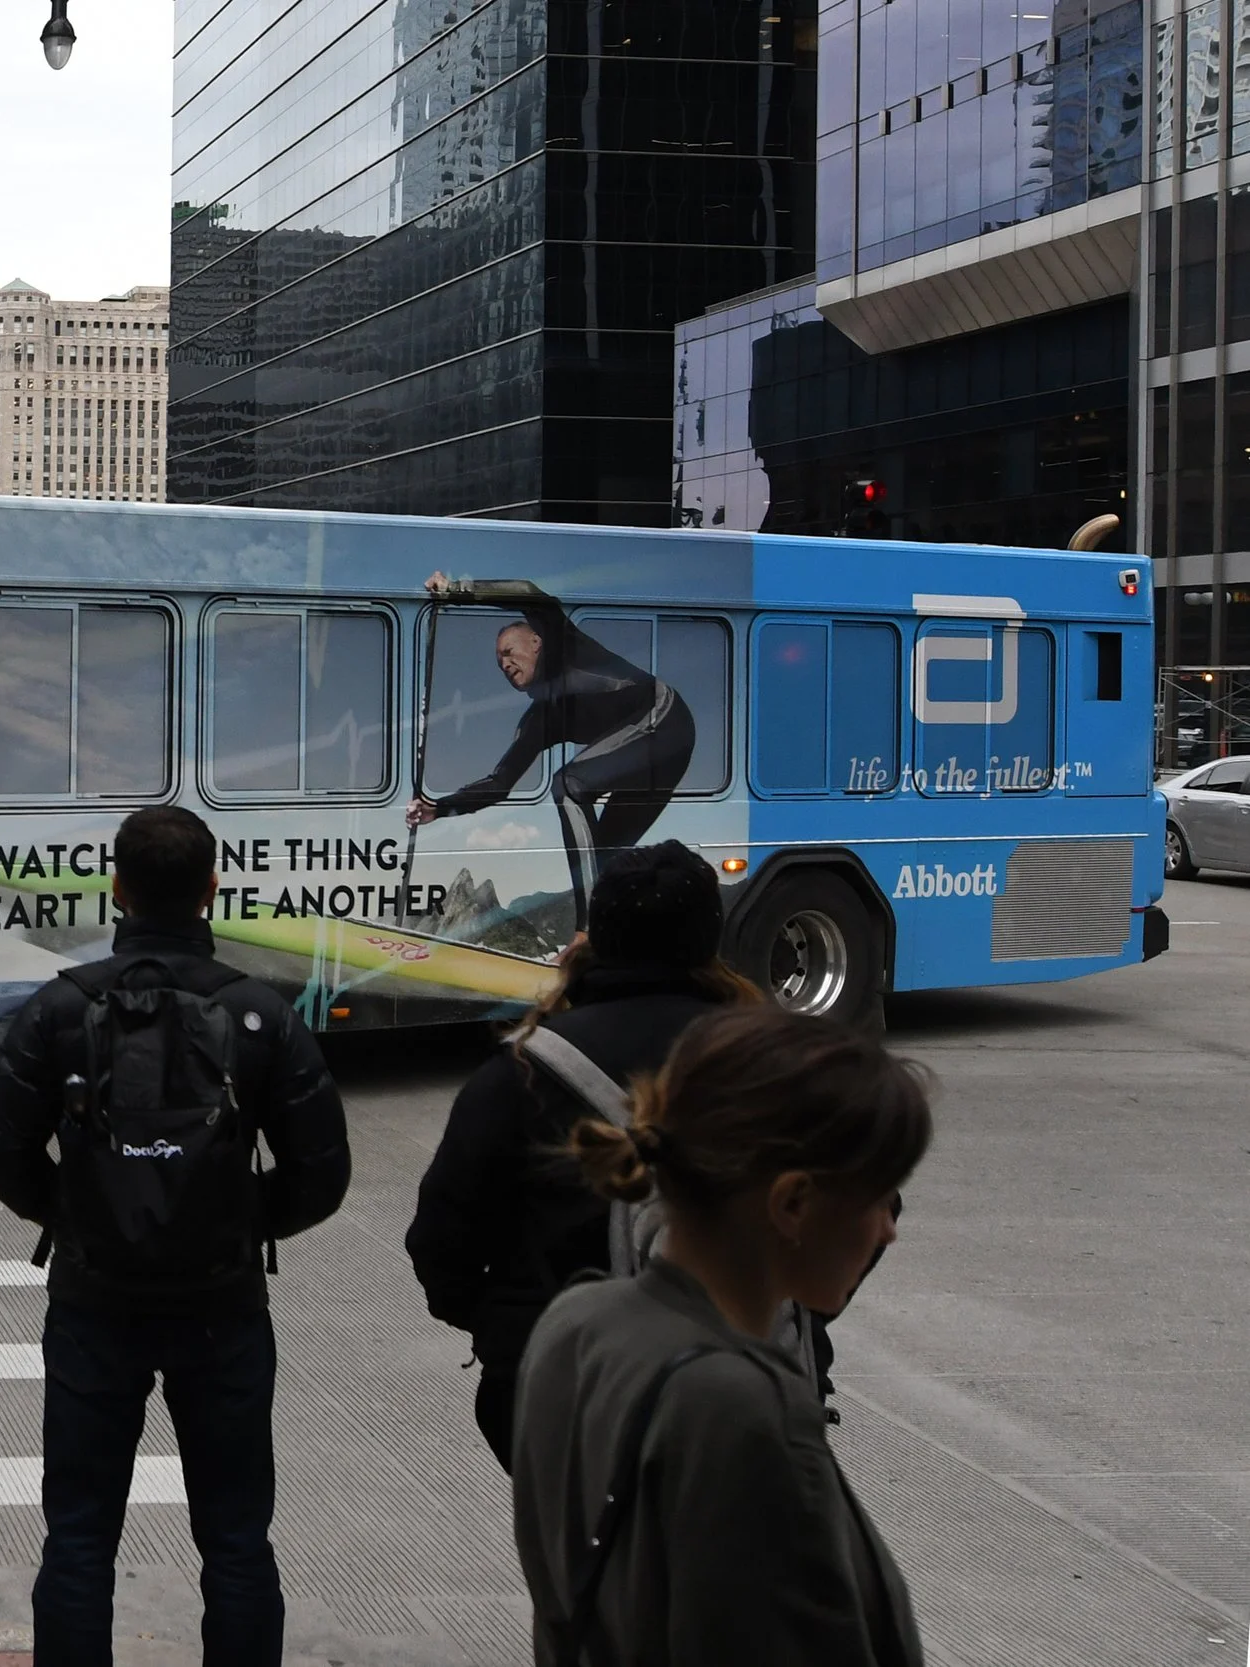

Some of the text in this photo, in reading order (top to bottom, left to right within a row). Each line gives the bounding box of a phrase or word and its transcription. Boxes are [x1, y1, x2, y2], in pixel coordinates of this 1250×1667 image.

[901, 762, 928, 792] to
[934, 756, 977, 792] the
[221, 839, 270, 872] NE
[284, 838, 410, 879] THING,
[892, 863, 997, 898] Abbott
[272, 884, 447, 919] ANOTHER
